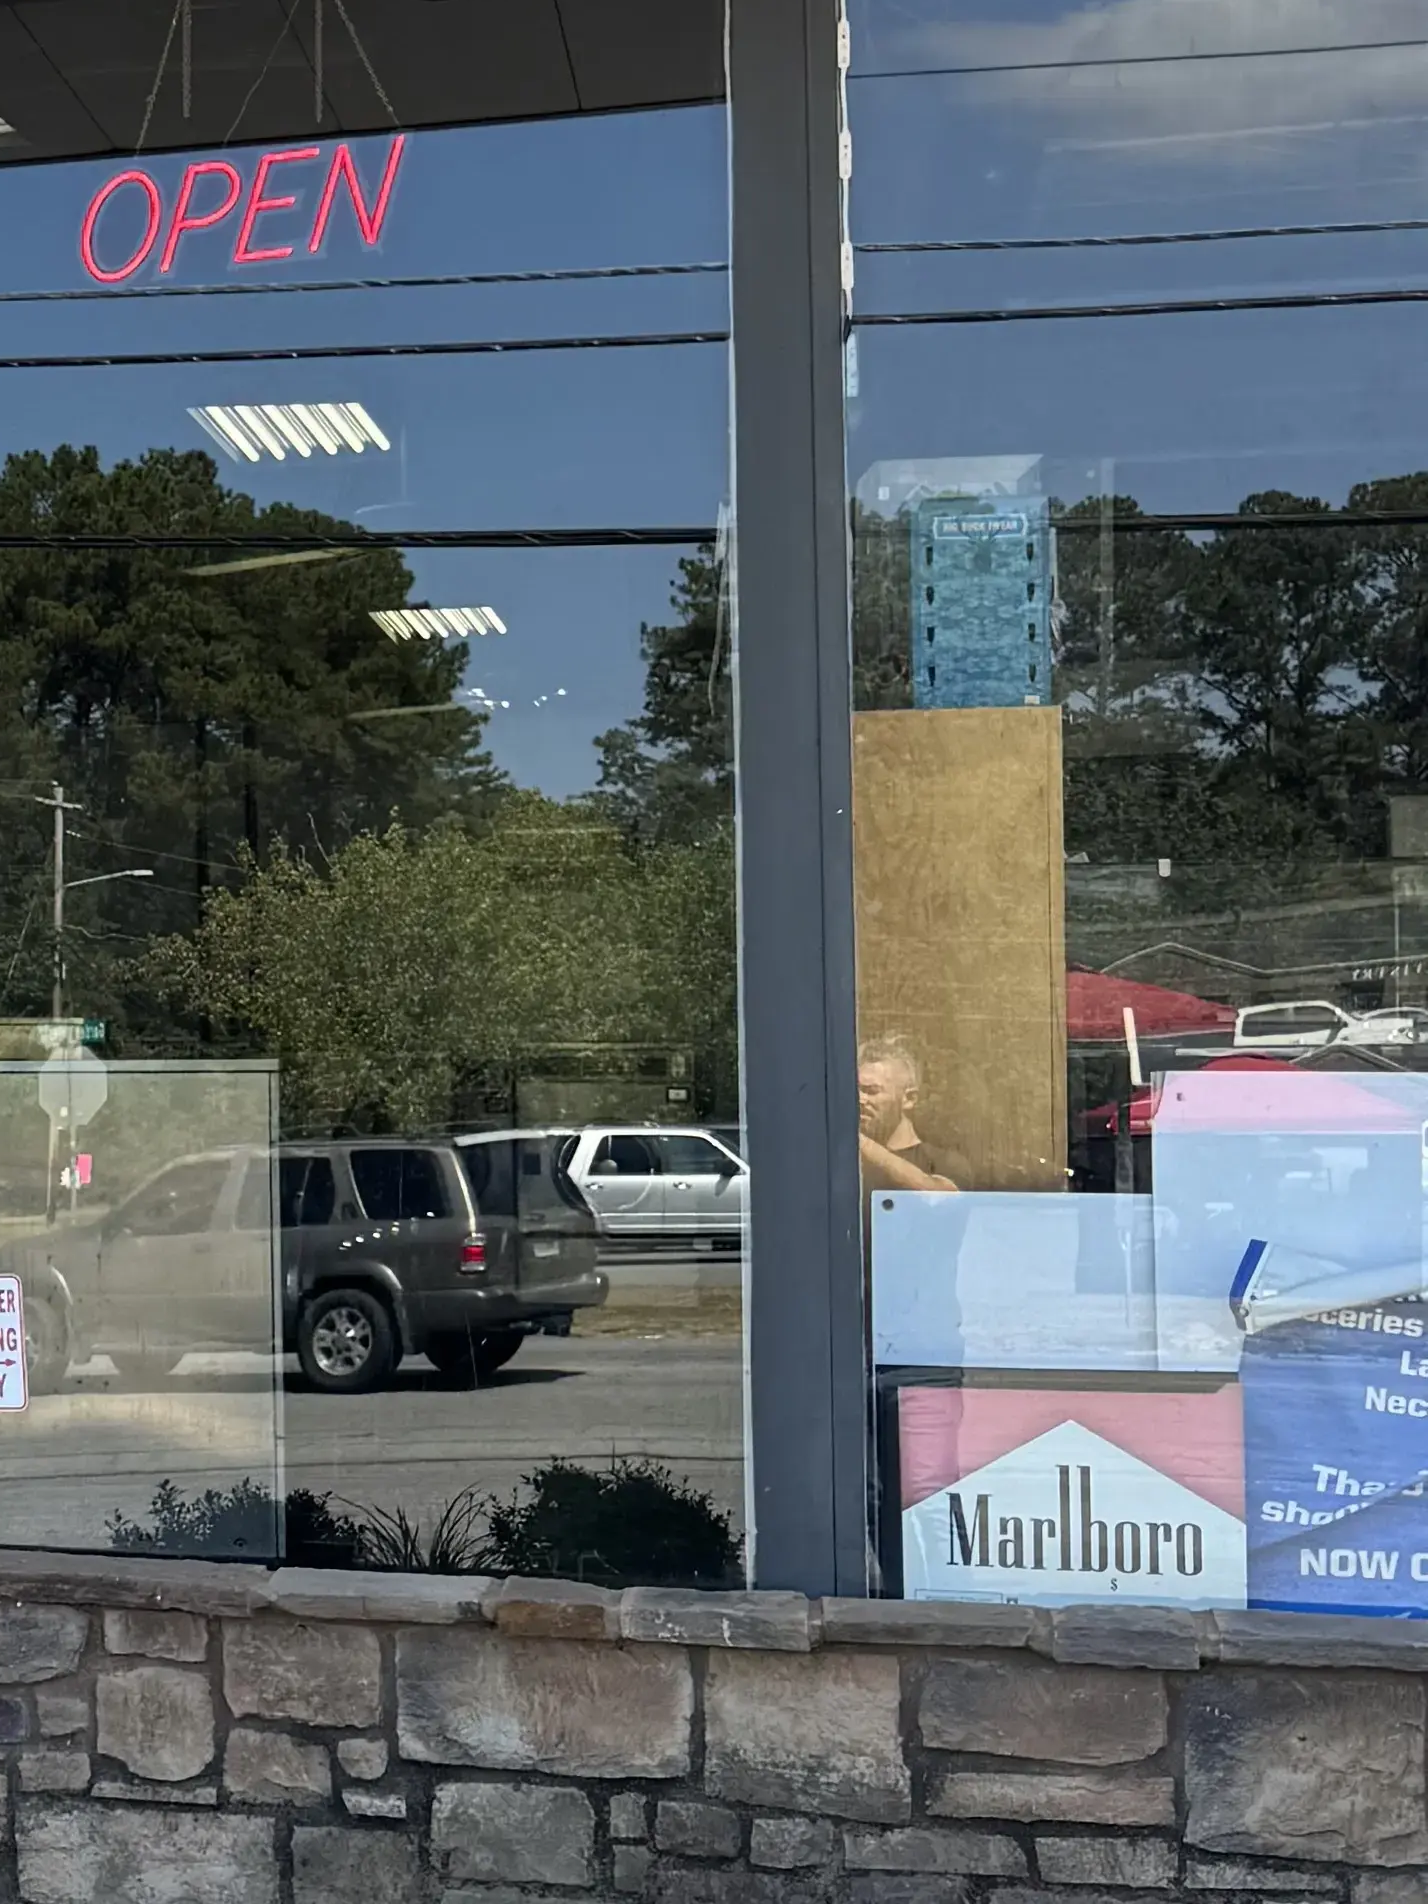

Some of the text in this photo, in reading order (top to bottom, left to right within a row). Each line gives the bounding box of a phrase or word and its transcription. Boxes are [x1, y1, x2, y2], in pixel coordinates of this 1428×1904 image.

[81, 134, 405, 283] OPEN
[1302, 1308, 1425, 1338] ceries
[944, 1464, 1204, 1578] Marlboro
[1300, 1548, 1400, 1580] NOW
